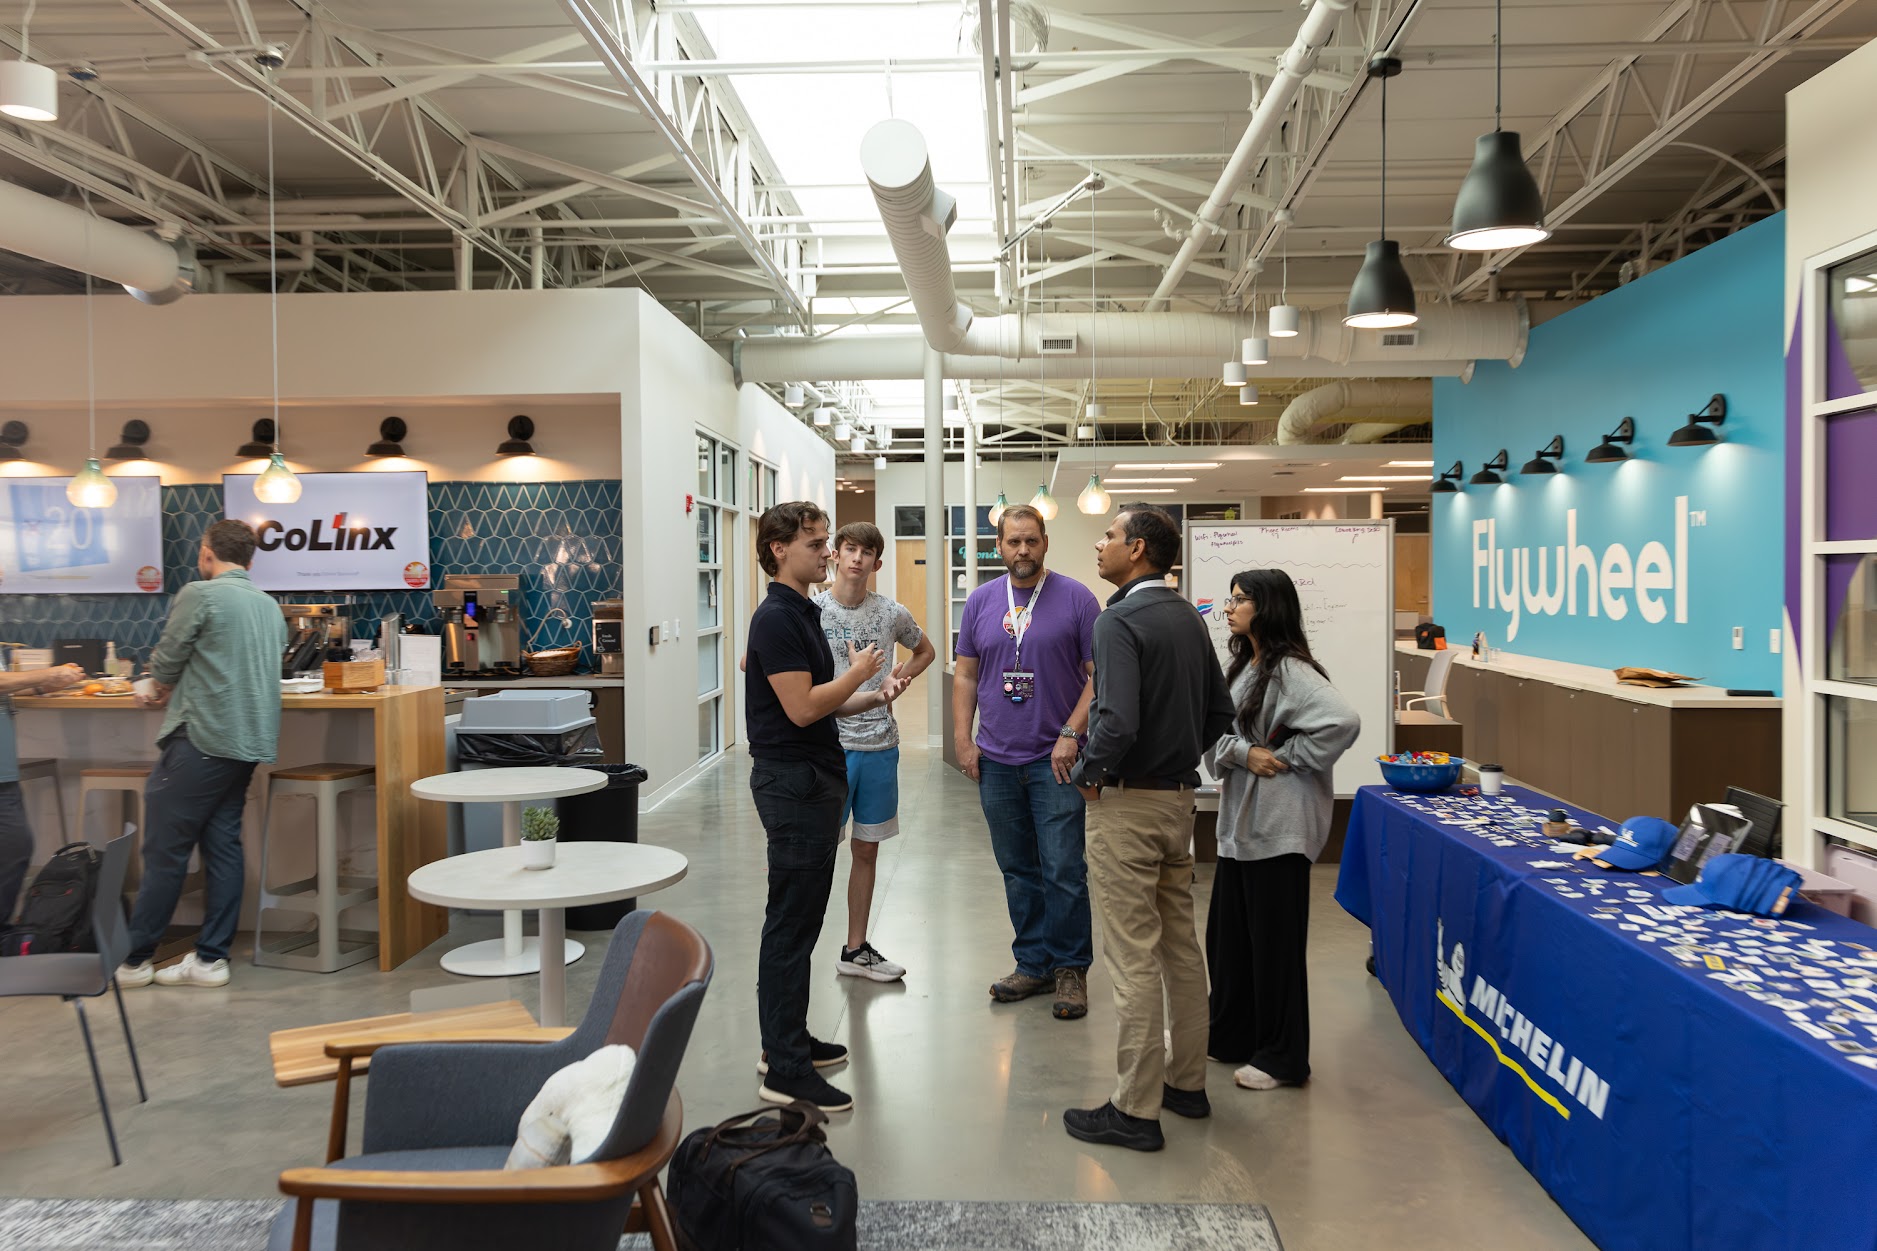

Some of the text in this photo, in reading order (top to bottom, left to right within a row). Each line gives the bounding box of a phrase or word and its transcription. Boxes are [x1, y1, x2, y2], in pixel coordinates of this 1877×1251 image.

[257, 513, 398, 551] CoLinx
[1473, 495, 1688, 642] Flywheel
[1469, 974, 1611, 1120] MICHELIN
